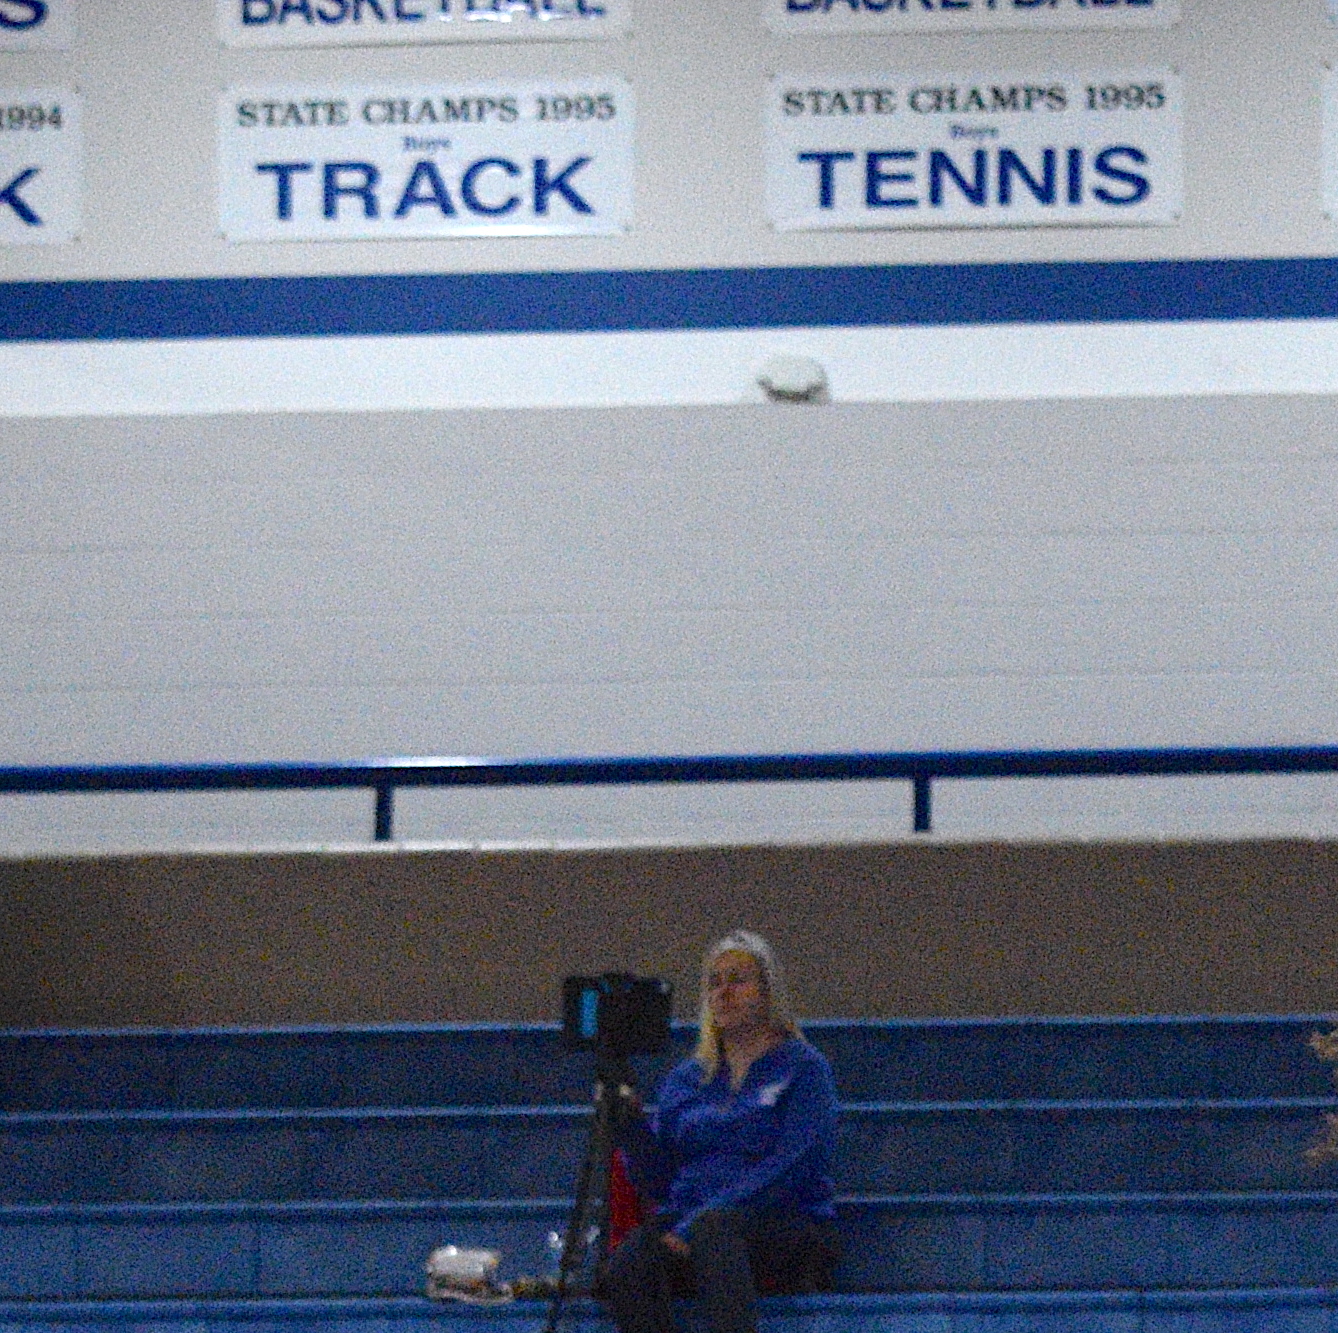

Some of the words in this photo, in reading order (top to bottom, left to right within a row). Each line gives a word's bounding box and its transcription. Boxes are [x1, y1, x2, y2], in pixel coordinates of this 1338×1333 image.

[236, 100, 349, 127] STATE
[361, 97, 519, 126] CHAMPS
[536, 94, 617, 121] 1995
[782, 87, 897, 116] STATE
[908, 84, 1067, 114] CHAMPS
[1084, 82, 1167, 110] 1995
[255, 156, 595, 221] TRACK
[796, 144, 1151, 210] TENNIS
